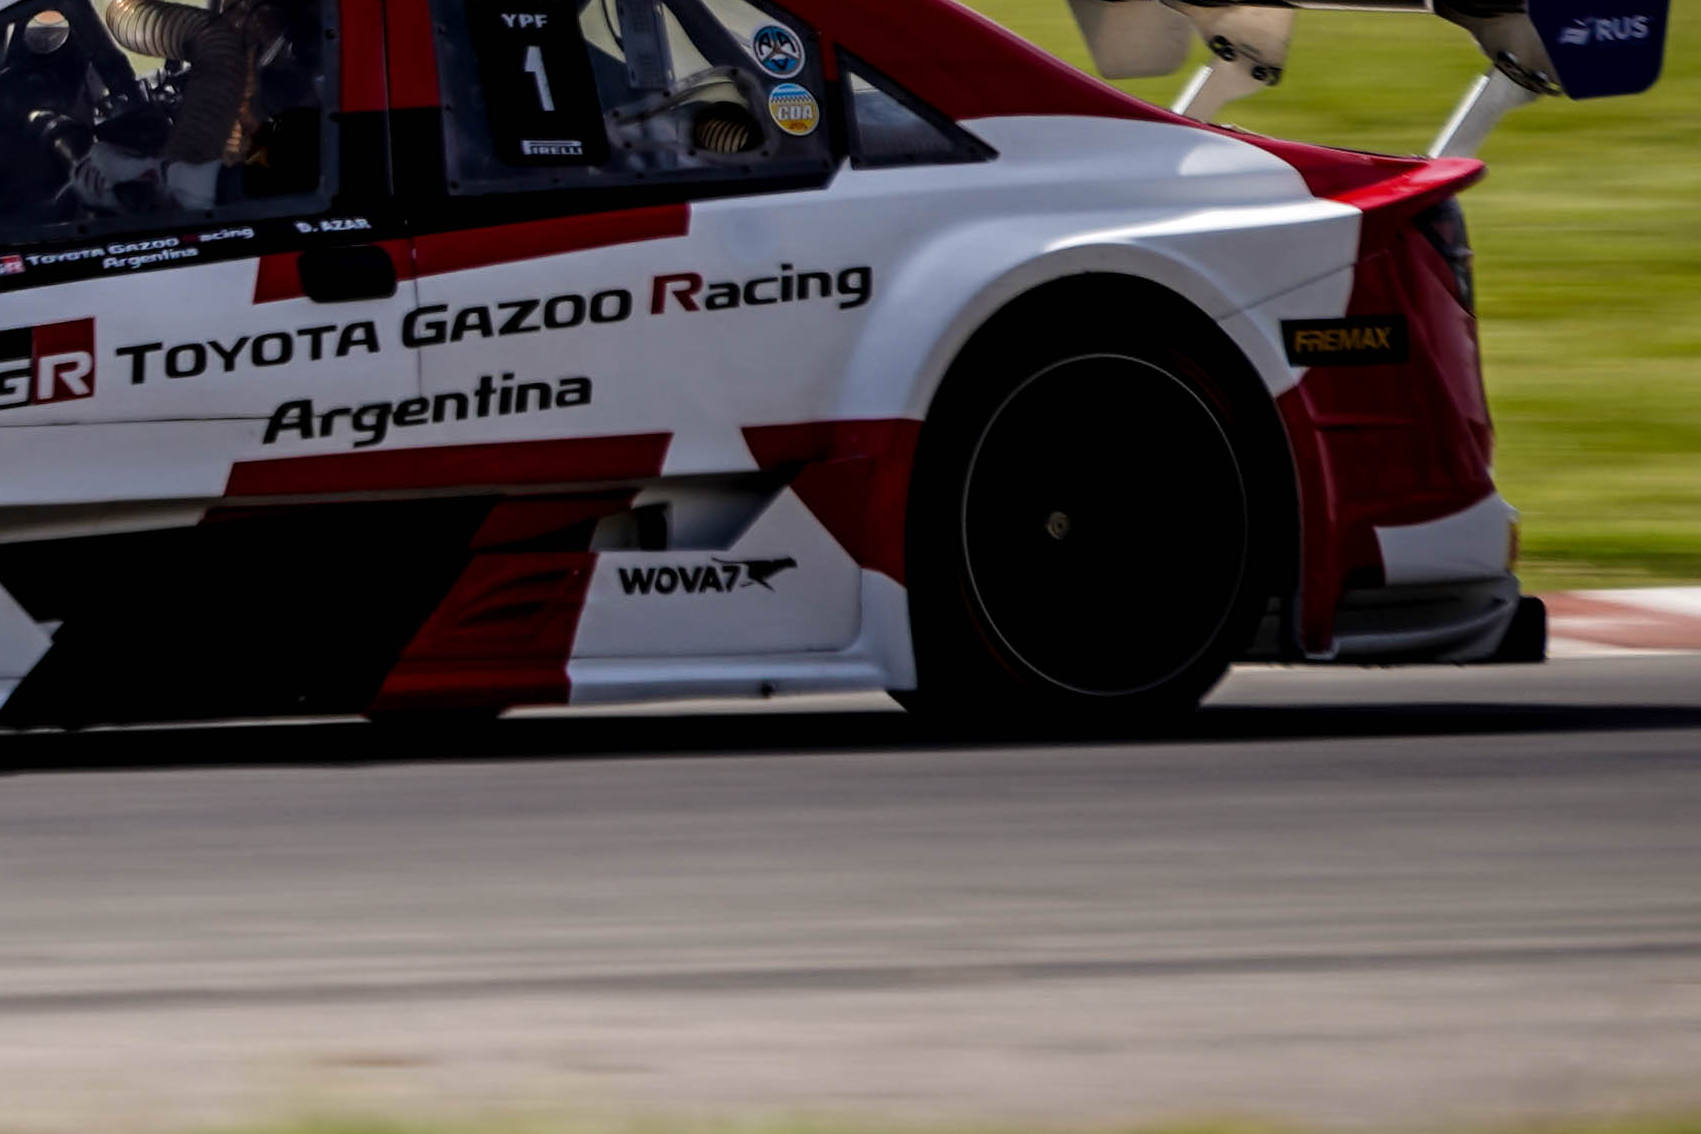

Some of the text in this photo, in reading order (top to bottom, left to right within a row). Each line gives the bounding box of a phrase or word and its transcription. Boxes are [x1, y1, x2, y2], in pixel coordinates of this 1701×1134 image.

[500, 13, 548, 29] YPF
[1594, 15, 1651, 42] RUS
[523, 45, 556, 112] 1
[520, 139, 585, 156] PIRELLI
[319, 217, 373, 233] AZAR
[26, 247, 106, 266] TOYOTA
[107, 236, 181, 256] GAZOO
[102, 245, 200, 271] Argentina
[115, 320, 381, 385] TOYOTA
[401, 287, 633, 349] GAZOO
[650, 264, 874, 317] Racing
[1293, 325, 1393, 354] FREMAX
[262, 372, 593, 448] Argentina
[618, 563, 741, 596] WOVA7
